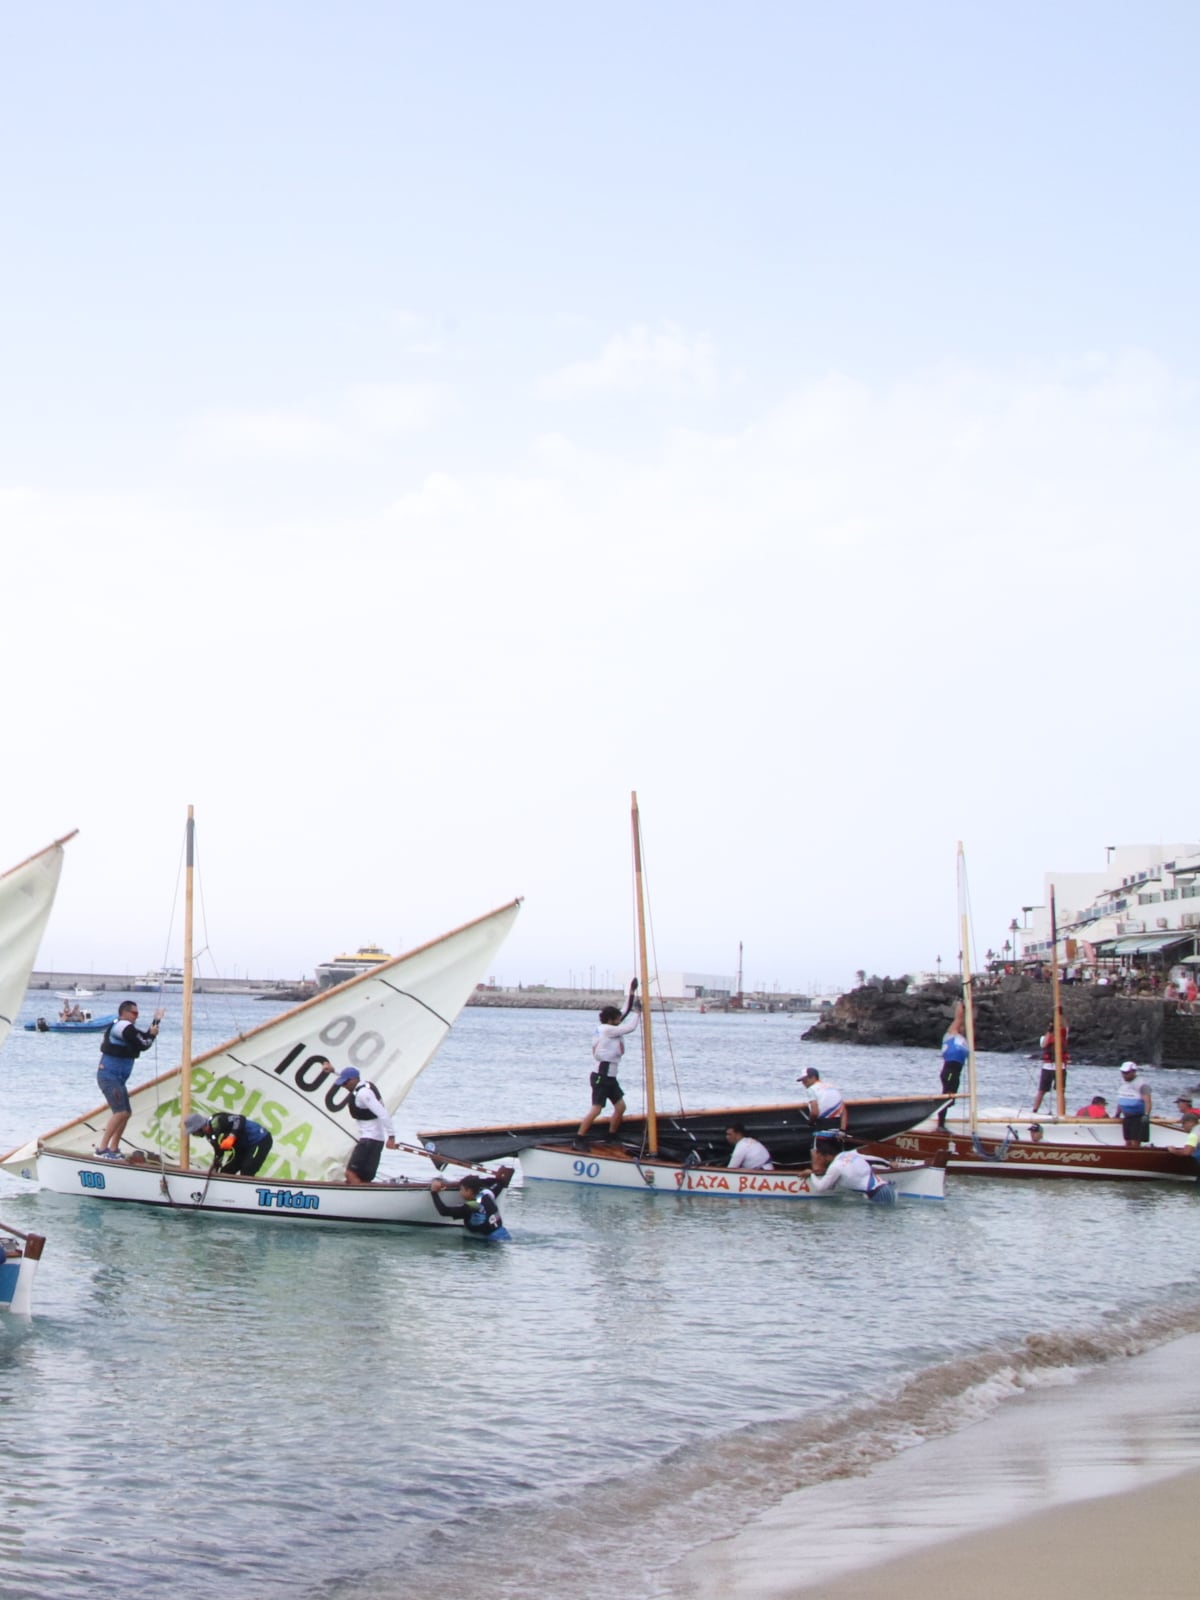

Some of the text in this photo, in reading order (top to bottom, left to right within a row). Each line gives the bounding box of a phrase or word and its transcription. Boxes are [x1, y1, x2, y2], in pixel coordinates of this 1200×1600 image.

[274, 1042, 354, 1113] 100
[179, 1066, 313, 1157] BRISA
[78, 1170, 105, 1189] 100
[572, 1160, 600, 1178] 90
[674, 1171, 810, 1193] PLAYA BLANCA
[256, 1188, 320, 1210] Tritón
